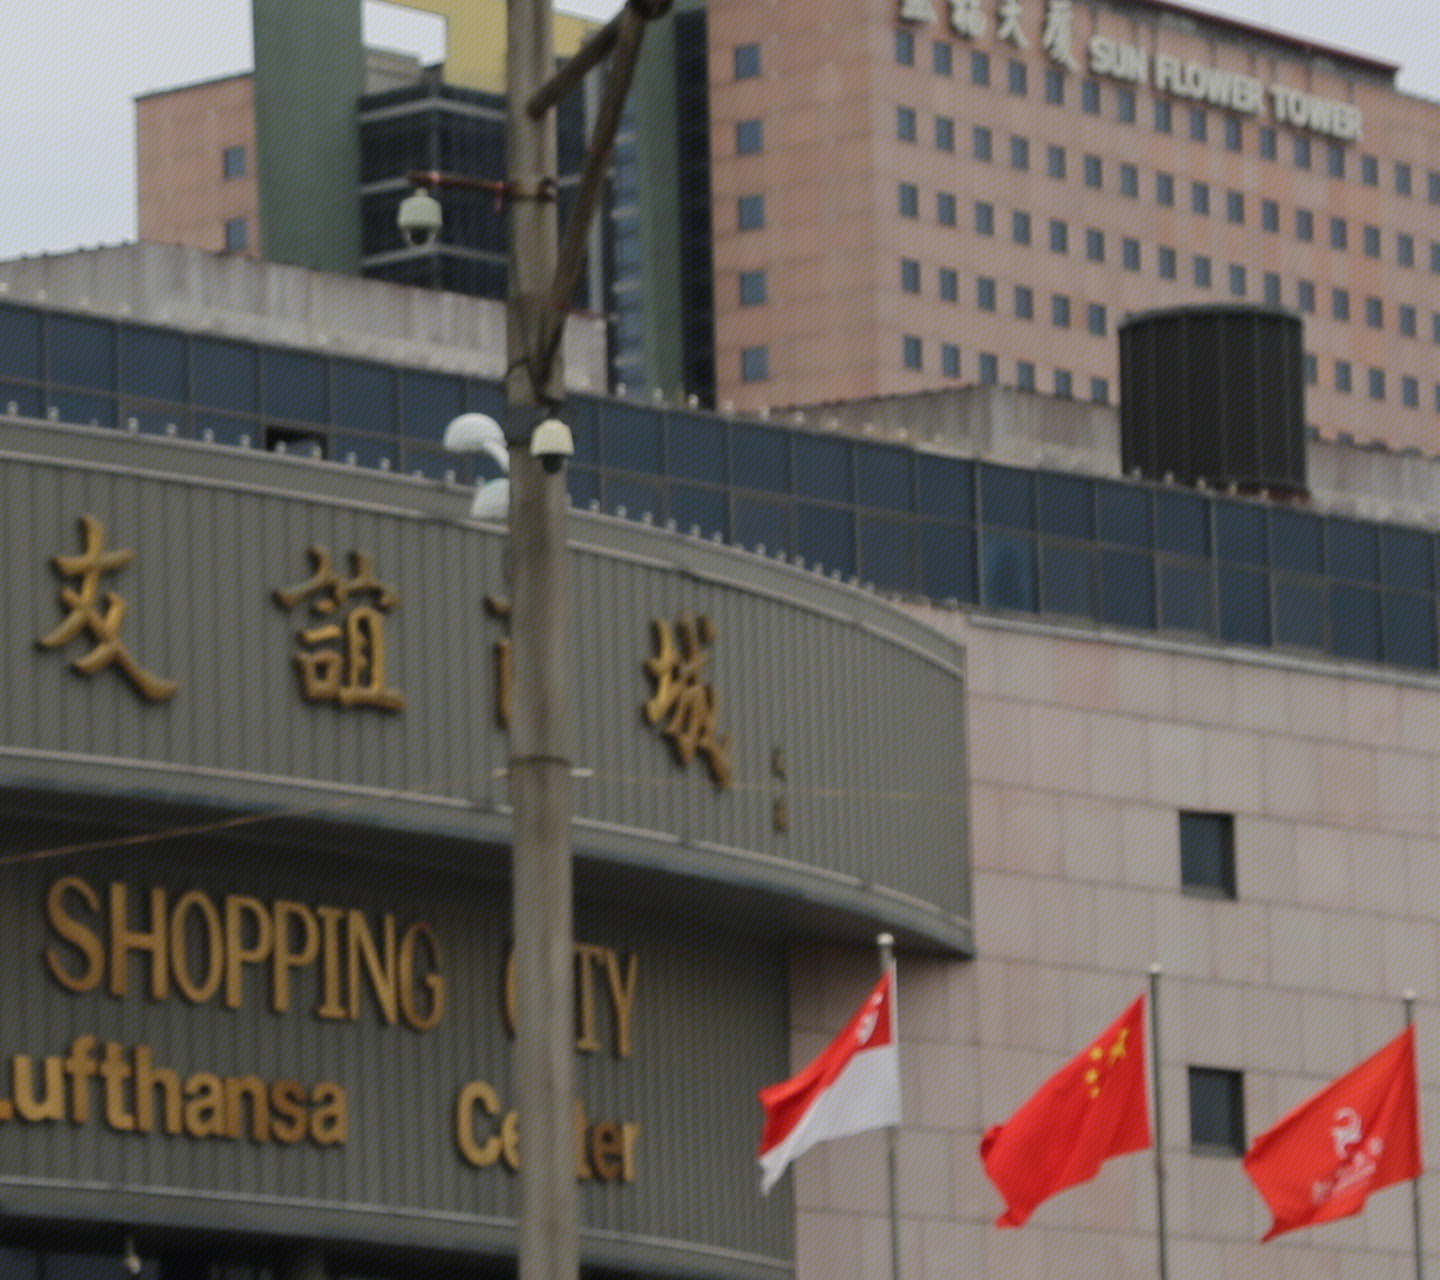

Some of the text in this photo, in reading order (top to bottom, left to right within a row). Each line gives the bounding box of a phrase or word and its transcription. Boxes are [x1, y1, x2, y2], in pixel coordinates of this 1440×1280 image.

[1088, 36, 1149, 84] SUN
[1154, 50, 1264, 115] FLOWER
[1270, 82, 1364, 141] TOWER
[45, 874, 446, 1032] SHOPPING
[501, 941, 640, 1058] TY
[455, 1080, 642, 1184] Ceter
